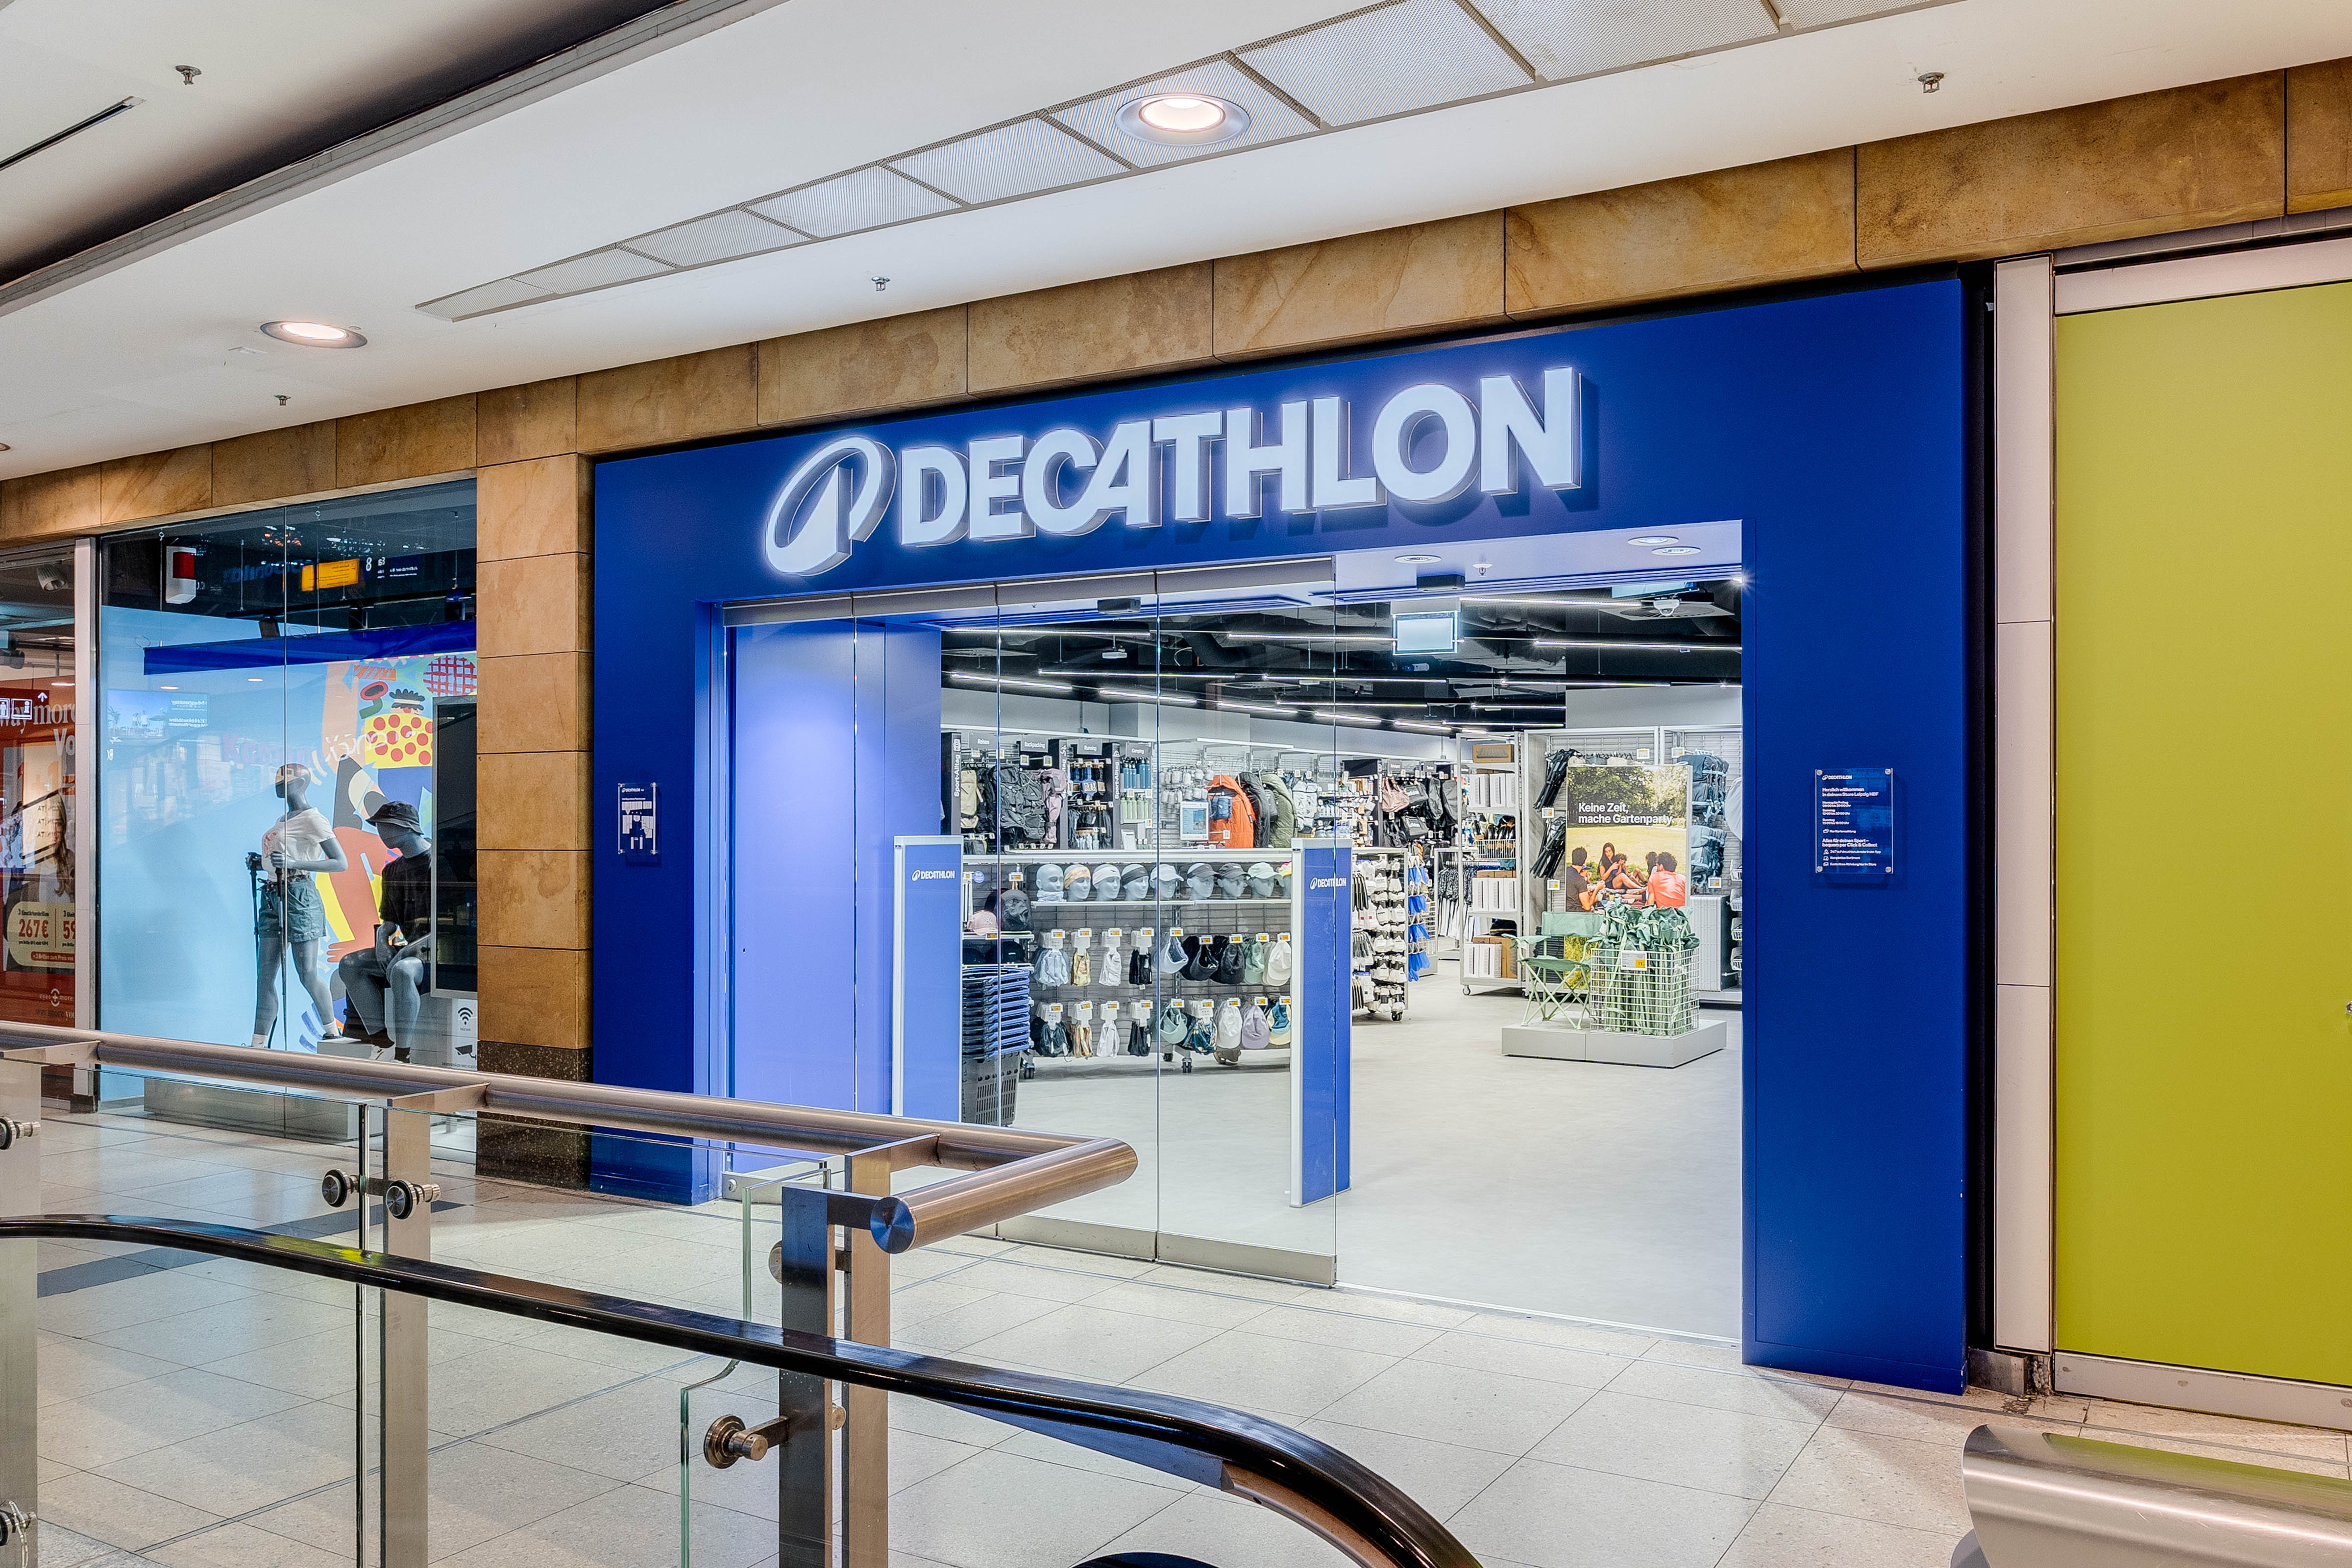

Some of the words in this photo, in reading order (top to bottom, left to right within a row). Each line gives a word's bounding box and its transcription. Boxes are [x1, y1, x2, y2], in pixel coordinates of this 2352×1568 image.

[901, 367, 1582, 548] DECATHLON
[1578, 803, 1605, 812] Keine
[1607, 803, 1629, 814] Zeit,
[1578, 814, 1611, 824] mache
[921, 870, 955, 880] DECATHLON
[1317, 878, 1347, 888] DECATLON
